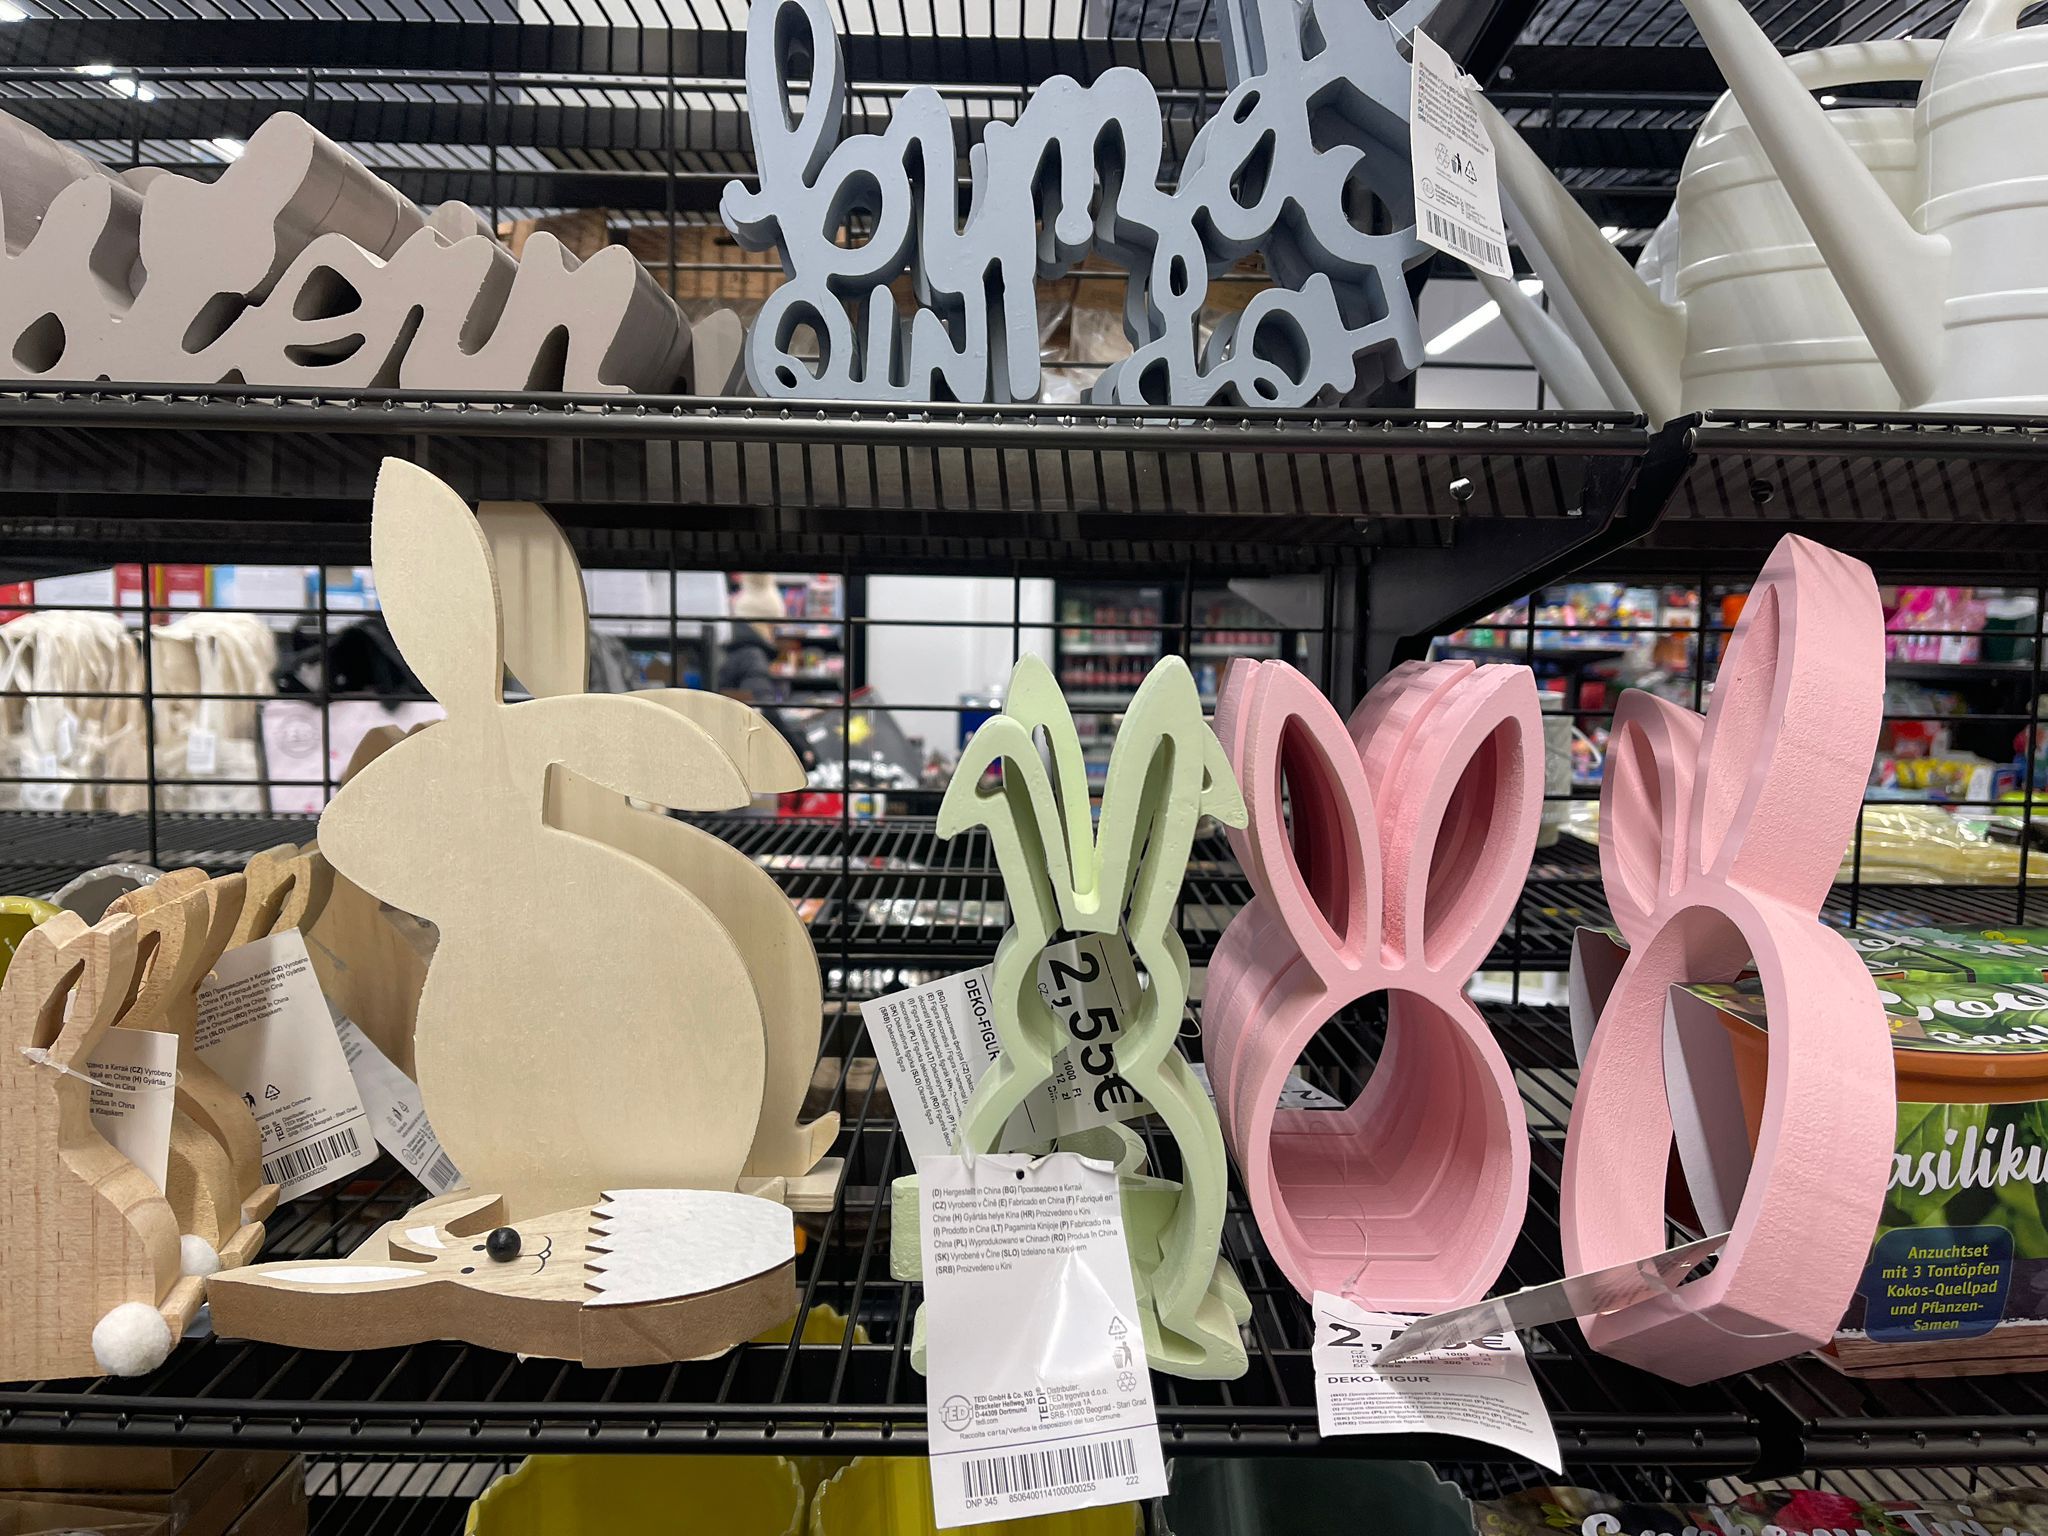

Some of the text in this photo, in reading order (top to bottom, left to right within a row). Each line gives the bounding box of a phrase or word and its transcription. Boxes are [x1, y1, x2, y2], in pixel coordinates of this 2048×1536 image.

[964, 979, 1000, 1061] DEKO-FIGUR
[1054, 1073, 1065, 1084] 12
[1061, 1059, 1082, 1097] 1000 Ft
[1887, 1123, 2048, 1195] asiliku
[983, 1187, 1001, 1195] China
[1002, 1185, 1016, 1195] (BG)
[932, 1201, 947, 1212] (CZ)
[947, 1201, 977, 1211] Vyrobeno
[998, 1198, 1007, 1208] (E)
[1008, 1197, 1037, 1206] Fabricado
[1047, 1196, 1065, 1204] China
[1066, 1195, 1075, 1205] (F)
[932, 1215, 951, 1223] Chine
[952, 1213, 962, 1223] (H)
[1020, 1210, 1035, 1220] (HR)
[1035, 1209, 1072, 1217] Proizvedeno
[941, 1226, 967, 1235] Prodotto
[975, 1225, 989, 1233] Cina
[991, 1224, 1003, 1234] (LT)
[1060, 1220, 1069, 1230] (P)
[934, 1240, 952, 1248] China
[954, 1238, 967, 1249] (PL)
[1025, 1234, 1050, 1243] Chinach
[1051, 1233, 1066, 1243] (RO)
[1067, 1232, 1089, 1240] Produs
[935, 1252, 950, 1263] (SK)
[1001, 1248, 1020, 1258] (SLO)
[1908, 1244, 1989, 1259] Anzuchtset
[935, 1265, 955, 1276] (SRB)
[956, 1263, 994, 1273] Proizvedeno
[1000, 1262, 1012, 1270] Kini
[1882, 1262, 2000, 1279] mit 3 Tontöpfen
[1887, 1280, 1998, 1297] Kokos-Quellpad
[1891, 1301, 1984, 1315] und Pflanzen-
[1912, 1319, 1959, 1331] Samen
[1328, 1376, 1430, 1384] DEKO-FIGUR
[988, 1393, 1006, 1402] GmbH
[974, 1402, 1001, 1411] Brackeler
[975, 1405, 1027, 1418] D-44309 Dortmund
[1086, 1403, 1111, 1414] Beograd
[1131, 1398, 1147, 1406] Grad
[965, 1498, 982, 1509] DNP
[984, 1496, 998, 1507] 345
[1125, 1475, 1139, 1486] 222
